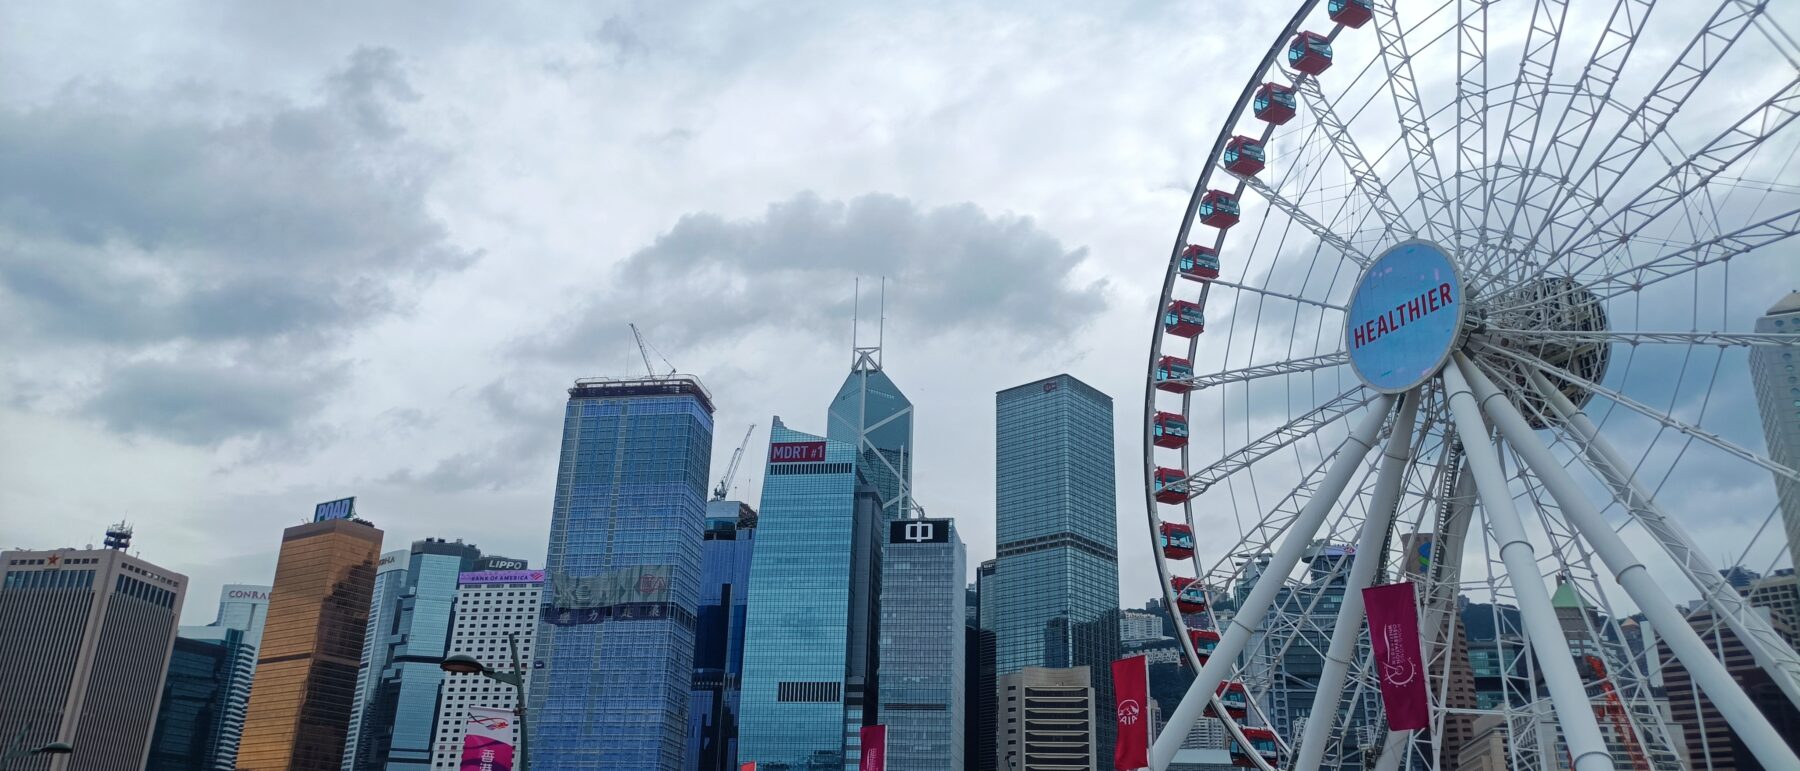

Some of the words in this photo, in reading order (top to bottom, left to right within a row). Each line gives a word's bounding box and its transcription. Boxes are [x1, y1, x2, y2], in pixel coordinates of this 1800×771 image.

[1354, 283, 1453, 349] HEALTHIER
[773, 446, 808, 459] MDRT
[811, 445, 824, 459] #1
[316, 500, 350, 522] POAD
[905, 521, 934, 542] 中
[488, 560, 522, 570] LIPPO
[1120, 715, 1138, 725] AIA
